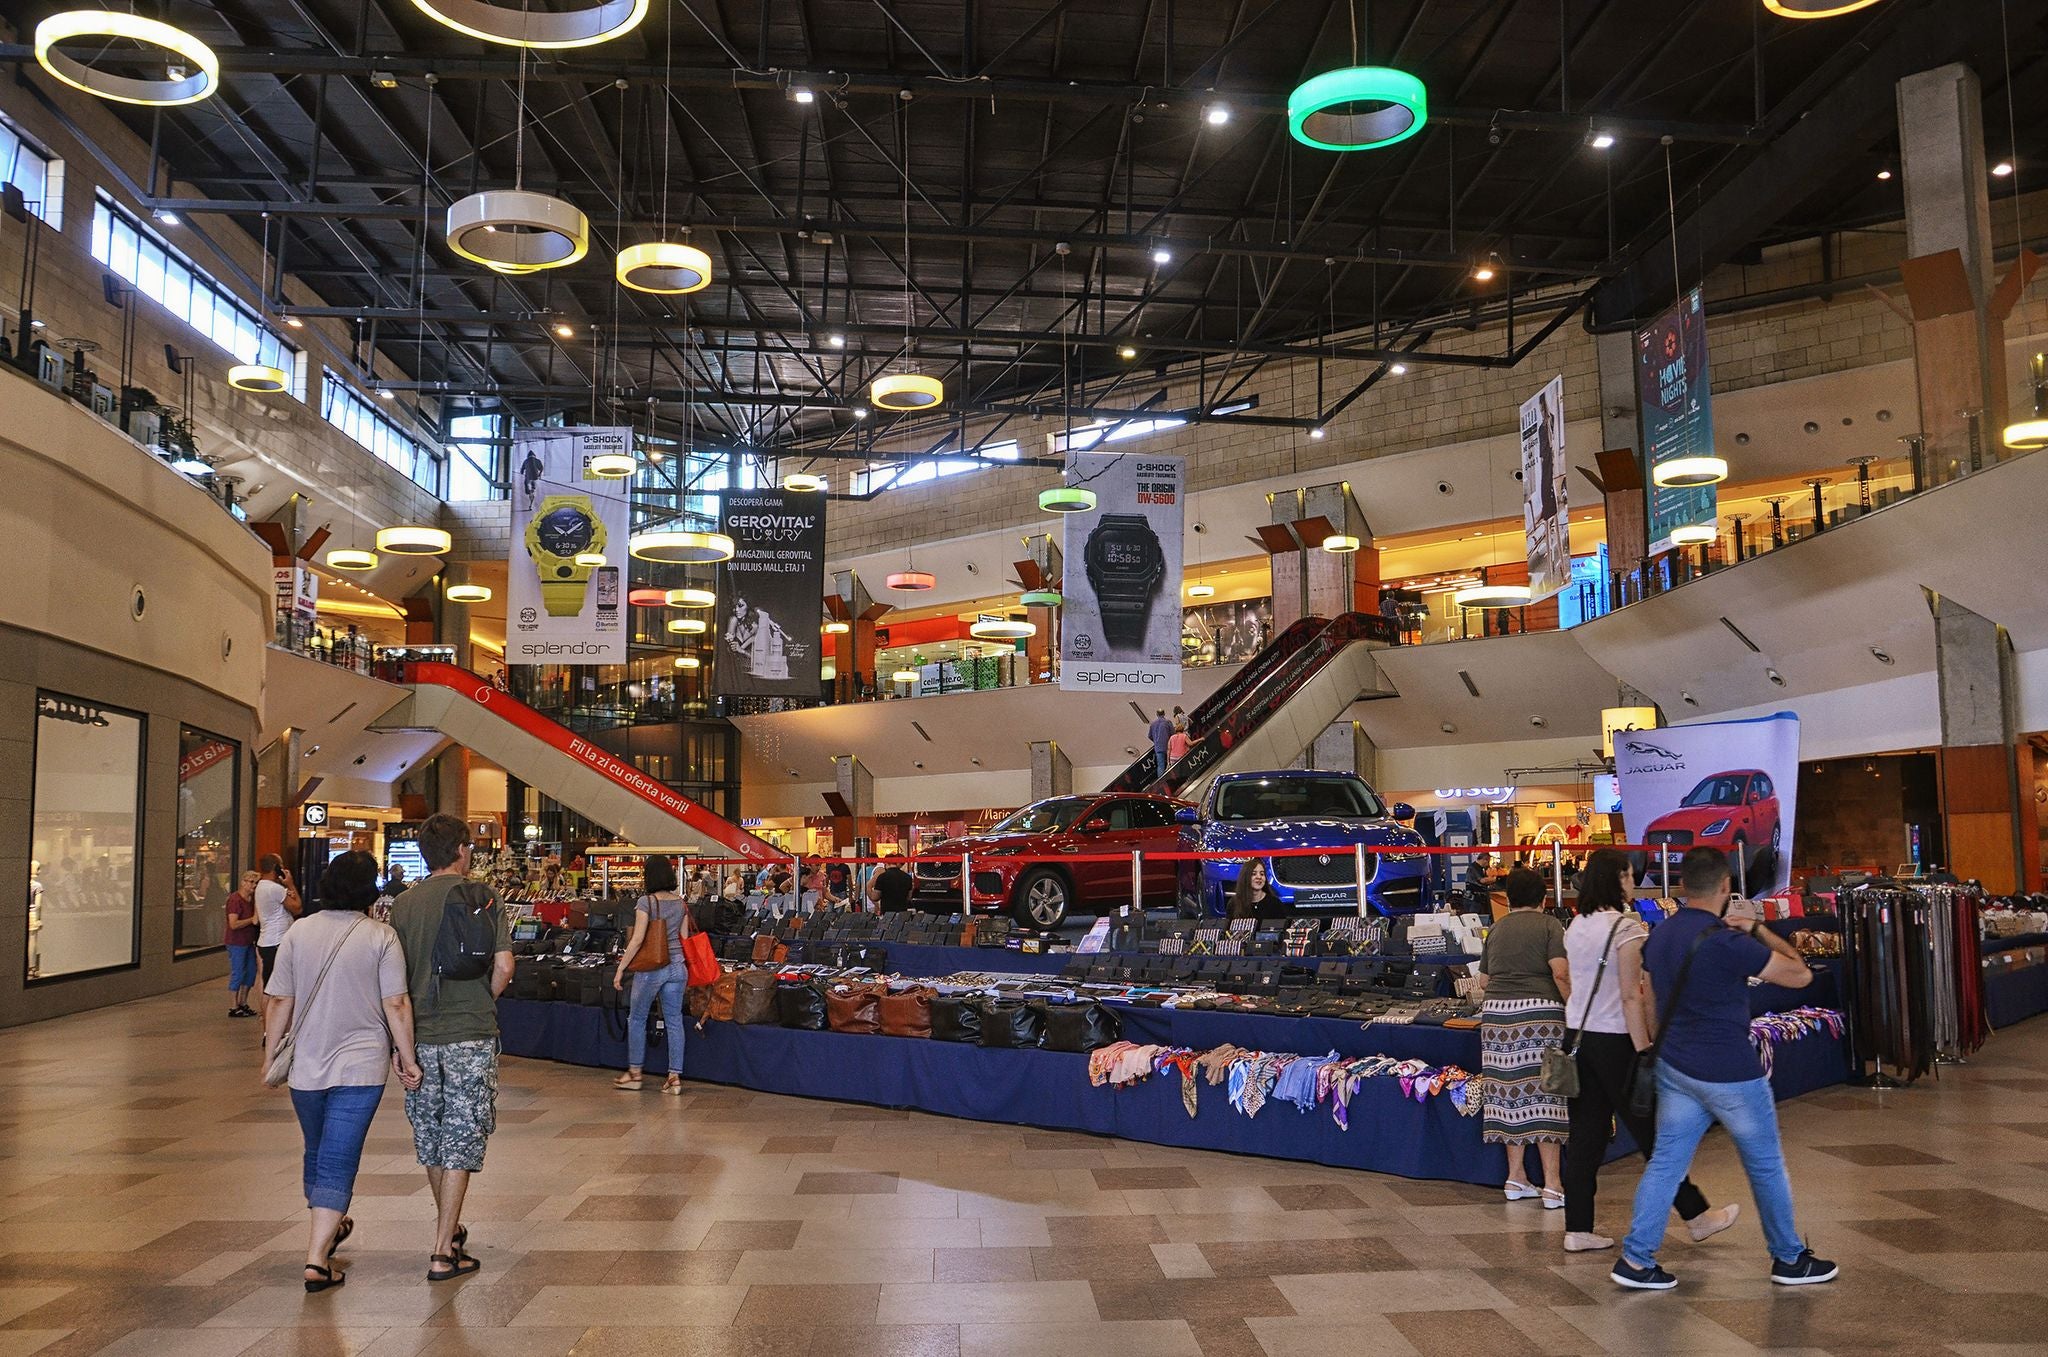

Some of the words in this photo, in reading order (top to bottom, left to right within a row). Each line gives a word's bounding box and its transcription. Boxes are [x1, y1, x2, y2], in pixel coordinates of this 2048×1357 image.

[1660, 376, 1687, 407] NIGHTS
[583, 435, 623, 443] G-SHOCK
[1136, 463, 1176, 472] G-SHOCK
[1137, 482, 1150, 493] THE
[1151, 483, 1176, 493] ORIGIN
[764, 498, 783, 507] GAMA
[1137, 492, 1175, 505] DW-5600
[736, 550, 775, 559] MAGAZINUL
[776, 550, 813, 560] GEROVITAL
[727, 562, 740, 571] DIN
[740, 562, 763, 572] IULIUS
[763, 563, 784, 574] MALL,
[784, 563, 800, 573] ETAJ
[801, 564, 805, 572] 1
[522, 641, 610, 658] splend'or
[1076, 669, 1166, 685] splend'or
[1187, 746, 1209, 769] NYX
[1625, 762, 1686, 775] JAGUAR
[569, 738, 585, 755] Fii
[585, 746, 596, 760] la
[596, 754, 610, 768] zi
[609, 763, 625, 778] cu
[624, 773, 659, 798] oferta
[660, 791, 690, 815] verii!
[1309, 892, 1347, 900] JAGUAR
